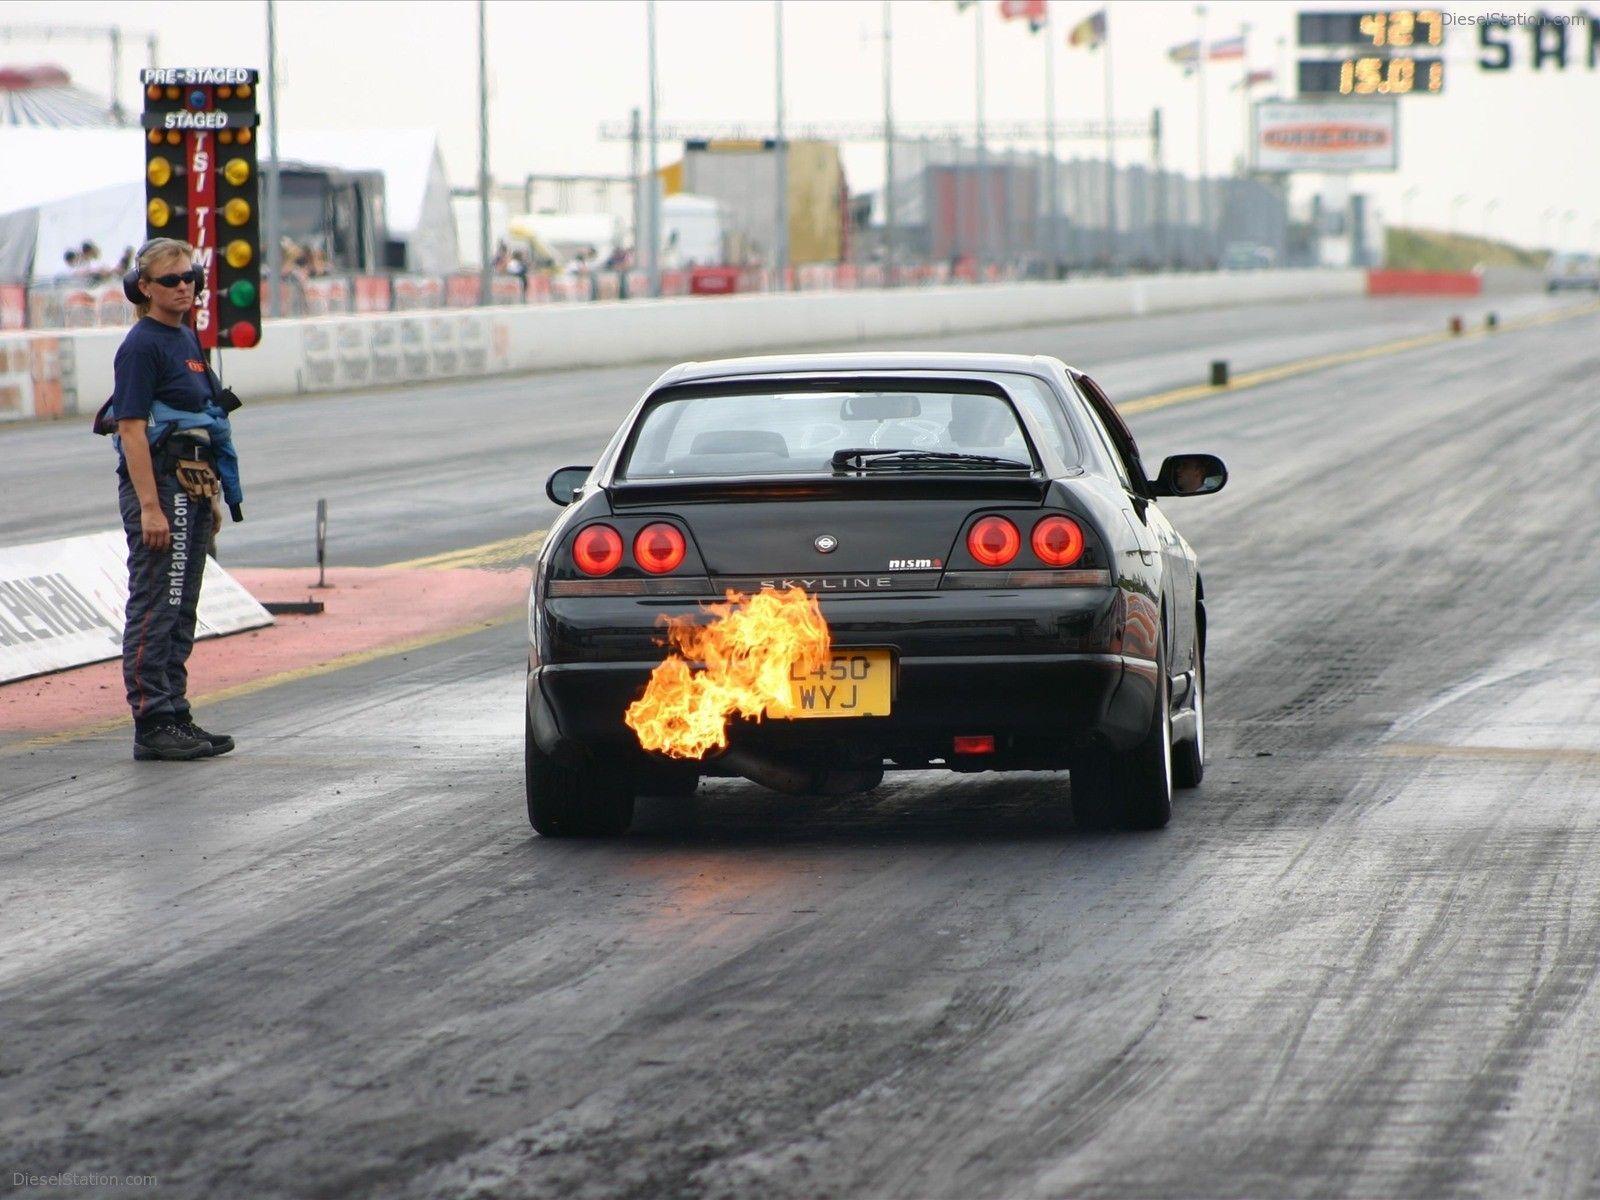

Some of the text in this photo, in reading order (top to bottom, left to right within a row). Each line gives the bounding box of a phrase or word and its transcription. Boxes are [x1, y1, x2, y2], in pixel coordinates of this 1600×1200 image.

[144, 68, 249, 84] PRE-STAGED
[164, 110, 228, 129] STAGED
[168, 492, 188, 606] santapod.com
[760, 577, 893, 590] SKYLINE
[799, 684, 858, 709] WYJ
